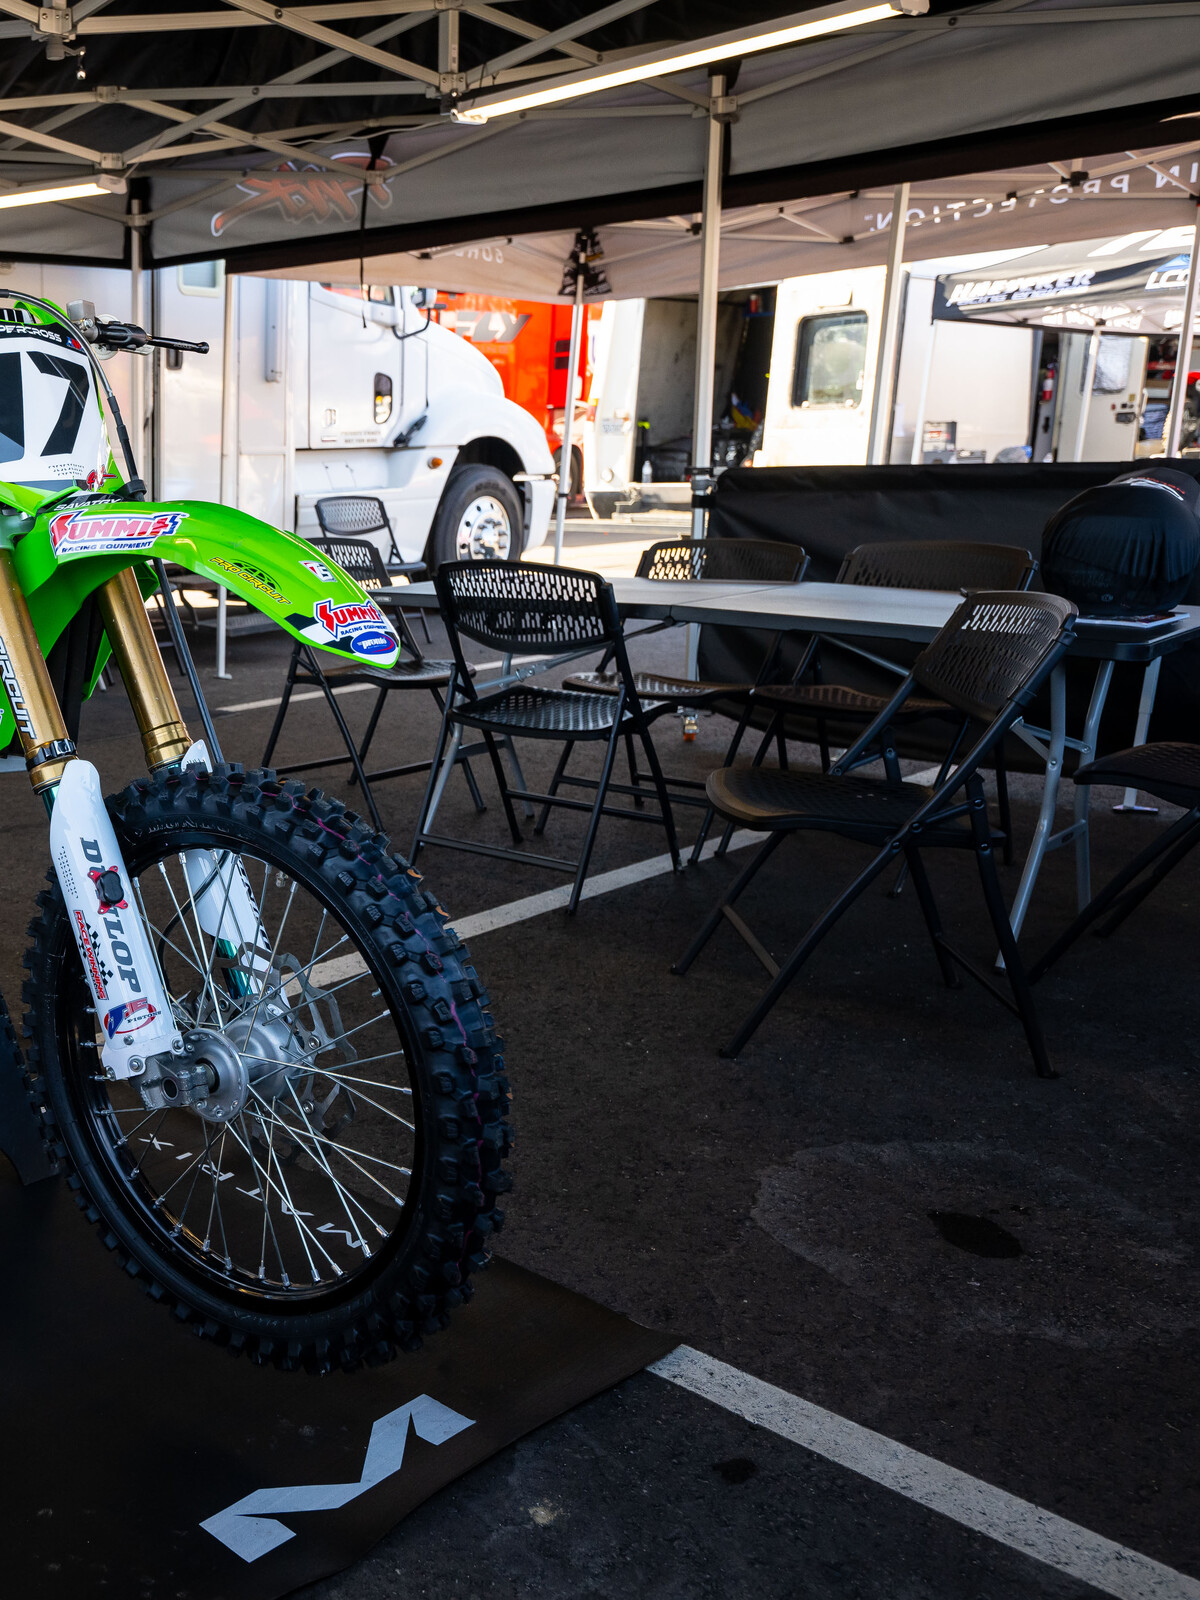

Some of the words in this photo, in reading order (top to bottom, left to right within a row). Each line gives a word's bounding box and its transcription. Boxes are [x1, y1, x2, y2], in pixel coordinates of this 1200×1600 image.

[455, 310, 533, 343] FLY
[51, 513, 170, 548] SUMMIT
[100, 540, 153, 551] EQUIPMENT
[209, 556, 238, 574] PRO
[238, 570, 292, 605] CIRCUIT
[318, 604, 382, 633] SUMMIT
[340, 625, 363, 636] RACING
[80, 836, 142, 993] DLOP
[74, 911, 90, 947] RACE
[86, 946, 107, 1000] WINNING
[127, 1009, 162, 1024] PISTONS
